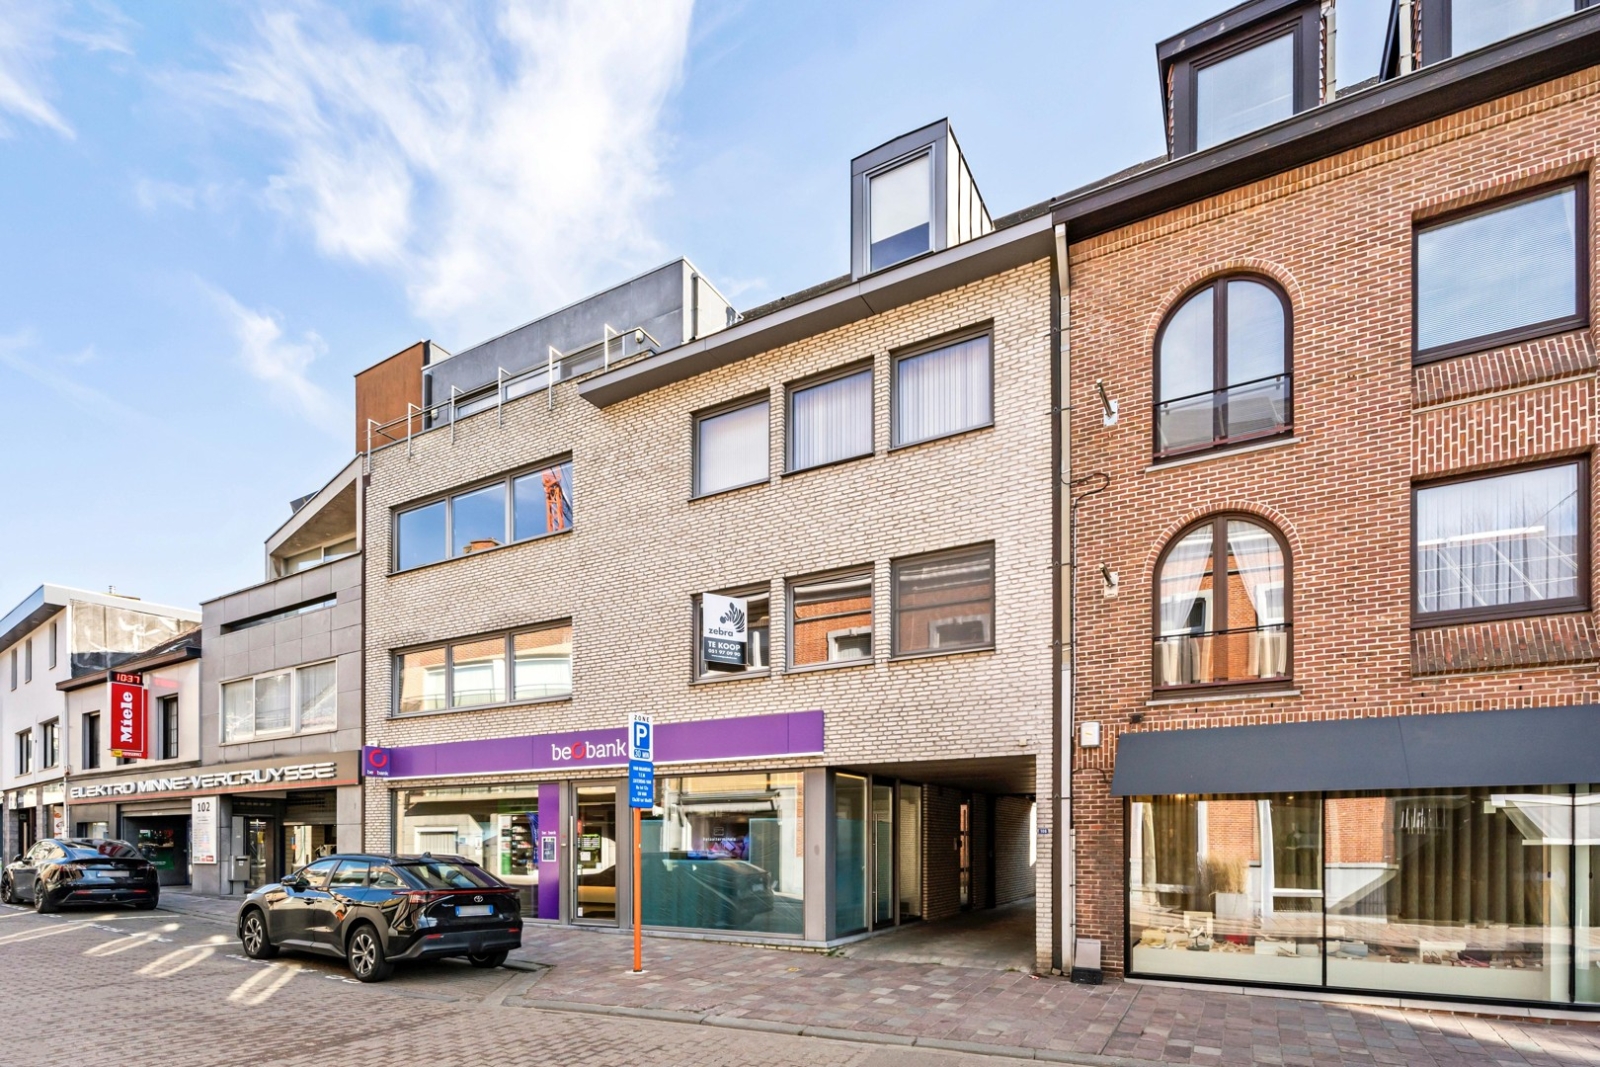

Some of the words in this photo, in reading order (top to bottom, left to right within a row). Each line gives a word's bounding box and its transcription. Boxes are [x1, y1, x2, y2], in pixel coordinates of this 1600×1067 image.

[708, 626, 734, 637] zebra
[708, 640, 716, 648] TE
[718, 642, 741, 651] KOOP
[120, 691, 133, 743] Miele
[634, 714, 650, 722] ZONE
[636, 724, 648, 746] P
[70, 781, 136, 800] ELEKTRO
[138, 761, 337, 793] MINNE-VERCRUYSSE
[197, 801, 211, 813] 102
